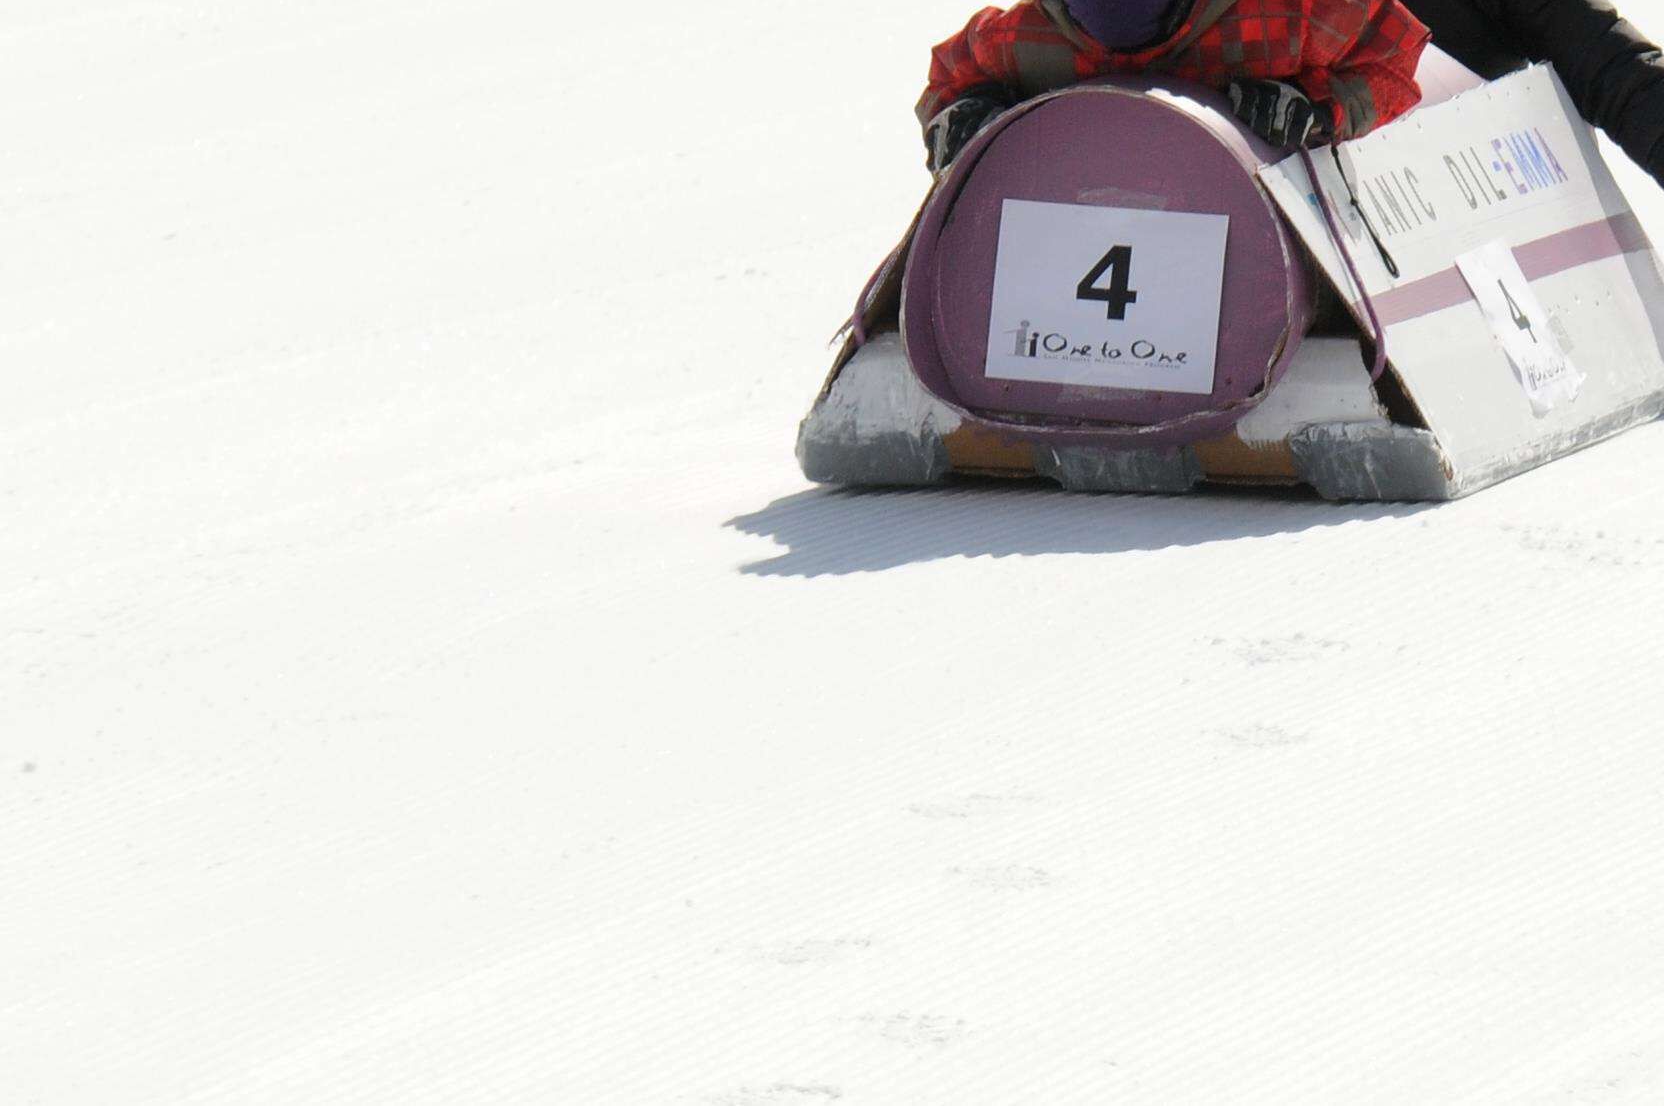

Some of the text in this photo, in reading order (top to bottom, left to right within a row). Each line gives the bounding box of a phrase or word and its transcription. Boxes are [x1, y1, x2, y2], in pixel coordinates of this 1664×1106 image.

[1075, 244, 1138, 321] 4
[1497, 278, 1538, 344] 4
[1042, 332, 1188, 365] One to One
